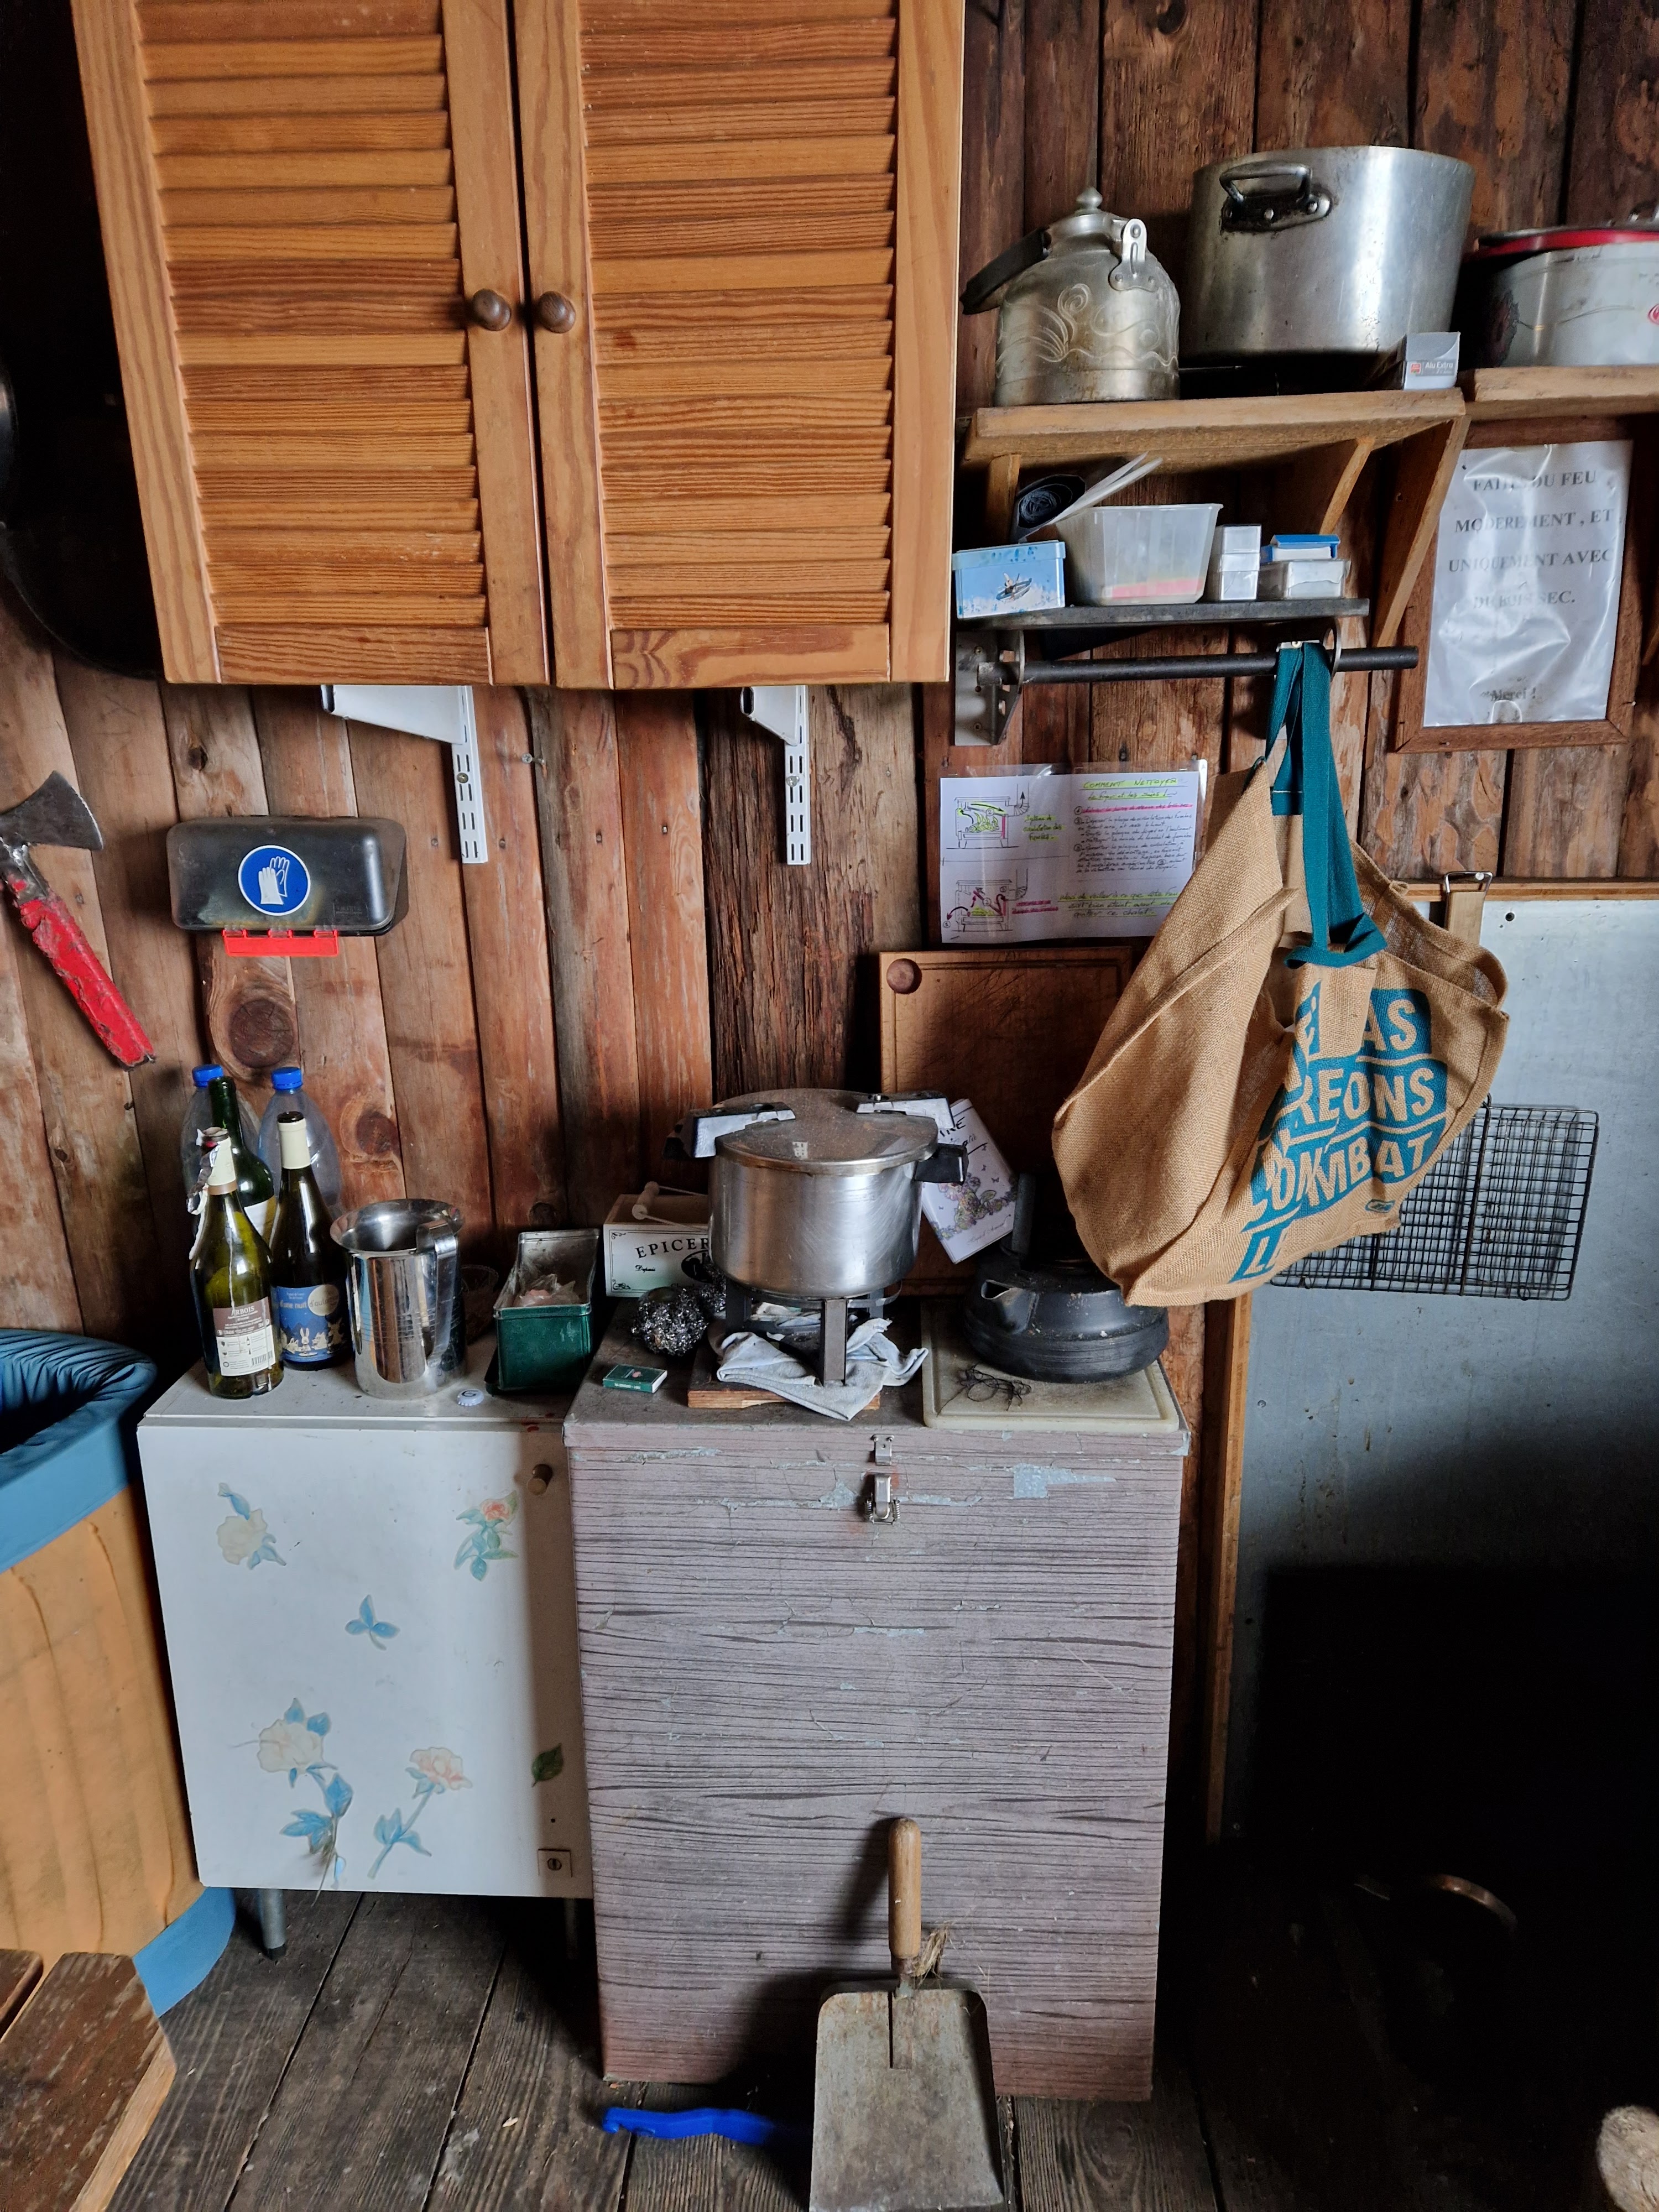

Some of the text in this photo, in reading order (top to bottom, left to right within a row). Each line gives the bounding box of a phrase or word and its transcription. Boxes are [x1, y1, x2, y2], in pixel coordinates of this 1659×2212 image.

[1561, 470, 1596, 486] FEU
[1590, 509, 1614, 524] ET
[1562, 548, 1615, 566] AVEC
[1083, 777, 1177, 789] COMMENT NETTOYER
[231, 1305, 255, 1316] ARBOIS
